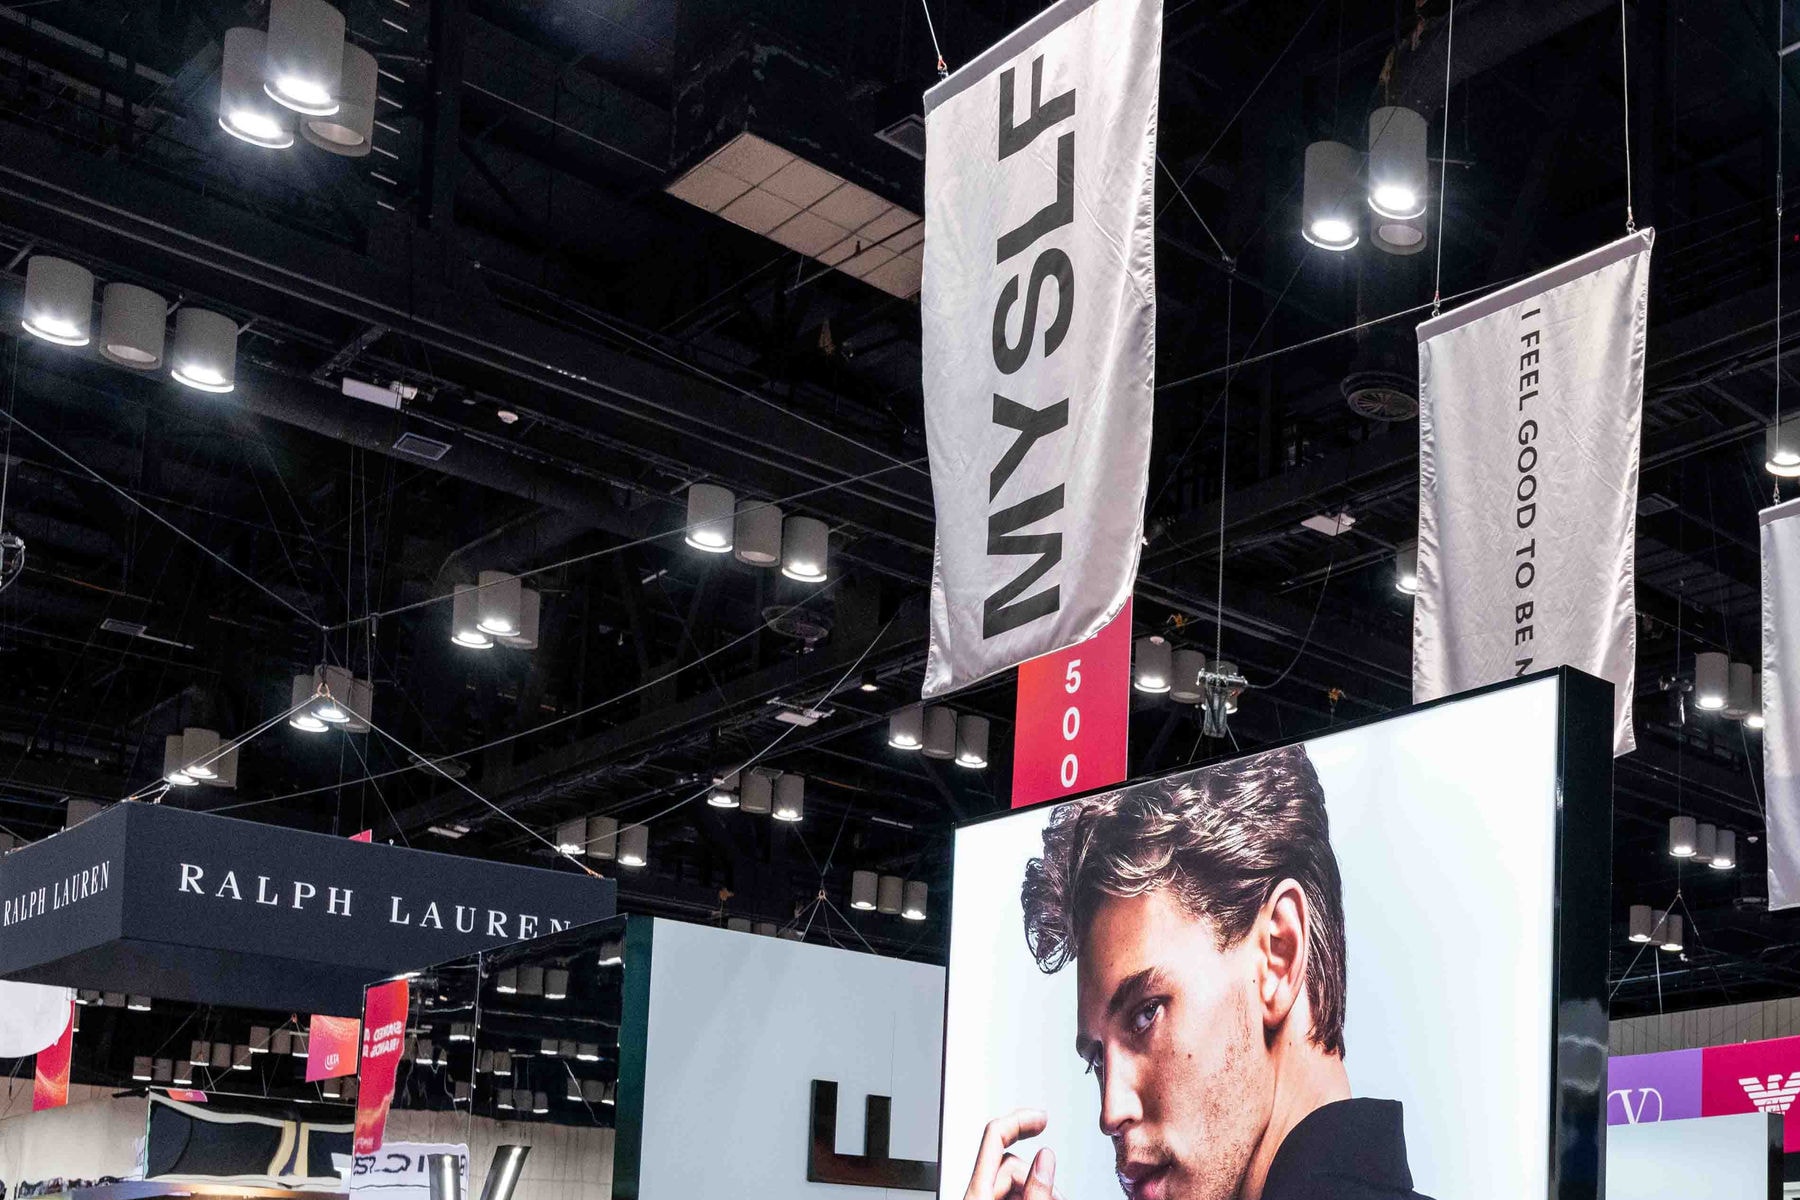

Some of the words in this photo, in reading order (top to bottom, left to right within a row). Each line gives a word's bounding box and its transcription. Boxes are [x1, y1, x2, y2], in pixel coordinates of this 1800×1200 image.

[1521, 307, 1541, 321] I
[982, 52, 1077, 641] MYSLF
[1518, 329, 1541, 412] FEEL
[1516, 418, 1539, 529] GOOD
[1515, 538, 1536, 589] TO
[1514, 600, 1534, 647] BE
[3, 886, 47, 927] RALPH
[52, 860, 110, 911] LAUREN
[178, 862, 353, 917] RALPH
